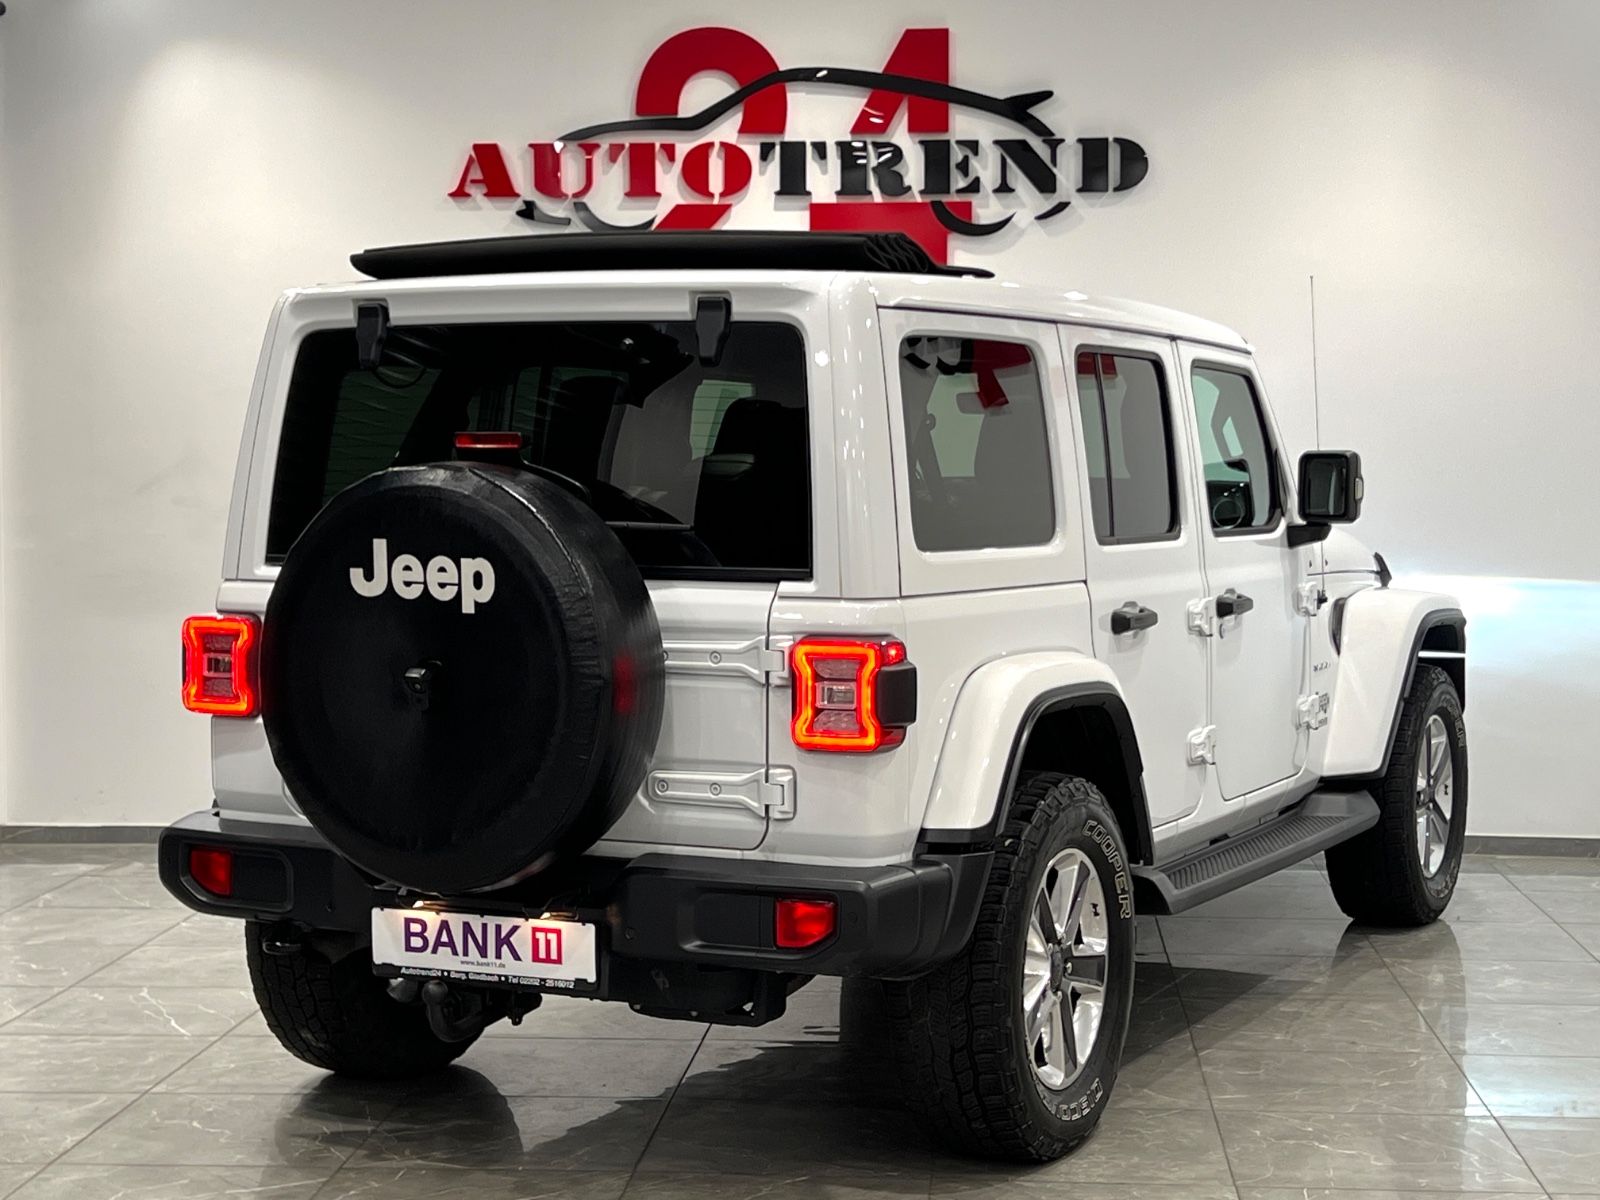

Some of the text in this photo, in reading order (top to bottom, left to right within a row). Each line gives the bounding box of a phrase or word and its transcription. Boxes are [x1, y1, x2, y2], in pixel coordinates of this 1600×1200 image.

[448, 137, 1149, 198] AUTOTREND
[636, 27, 972, 265] 24
[350, 538, 495, 614] Jeep
[1082, 819, 1132, 919] COOPER
[403, 916, 558, 962] BANK 11
[460, 959, 506, 969] www.bank11.de
